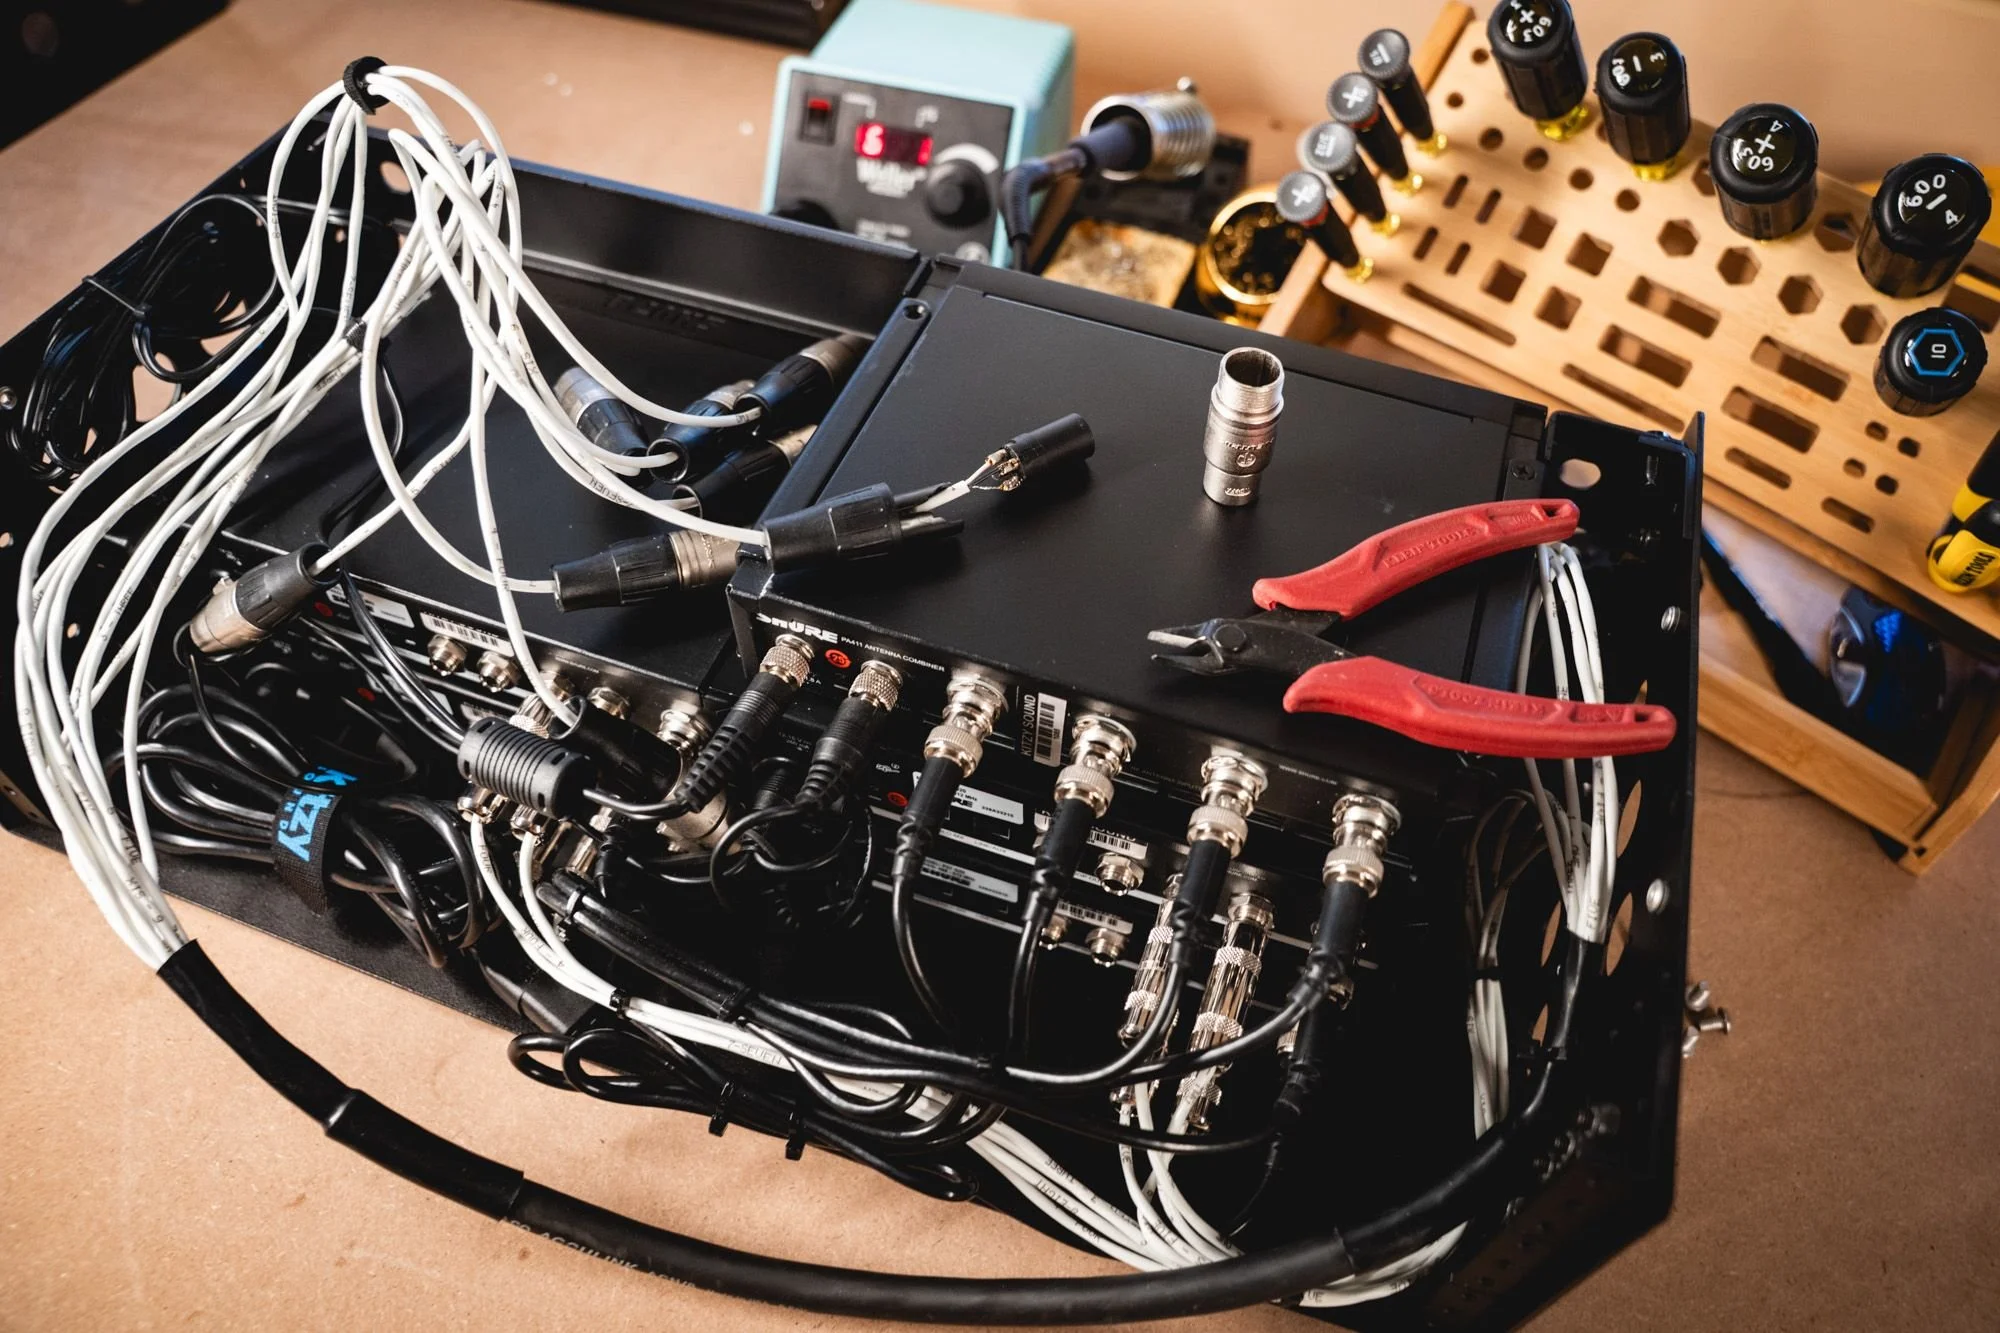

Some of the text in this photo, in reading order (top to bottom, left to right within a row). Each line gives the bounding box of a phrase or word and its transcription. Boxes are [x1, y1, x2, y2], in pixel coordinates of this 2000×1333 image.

[1931, 344, 1946, 358] 10
[864, 644, 902, 661] ANTENNA
[902, 654, 946, 673] COMBINER
[1023, 694, 1037, 729] SOUND
